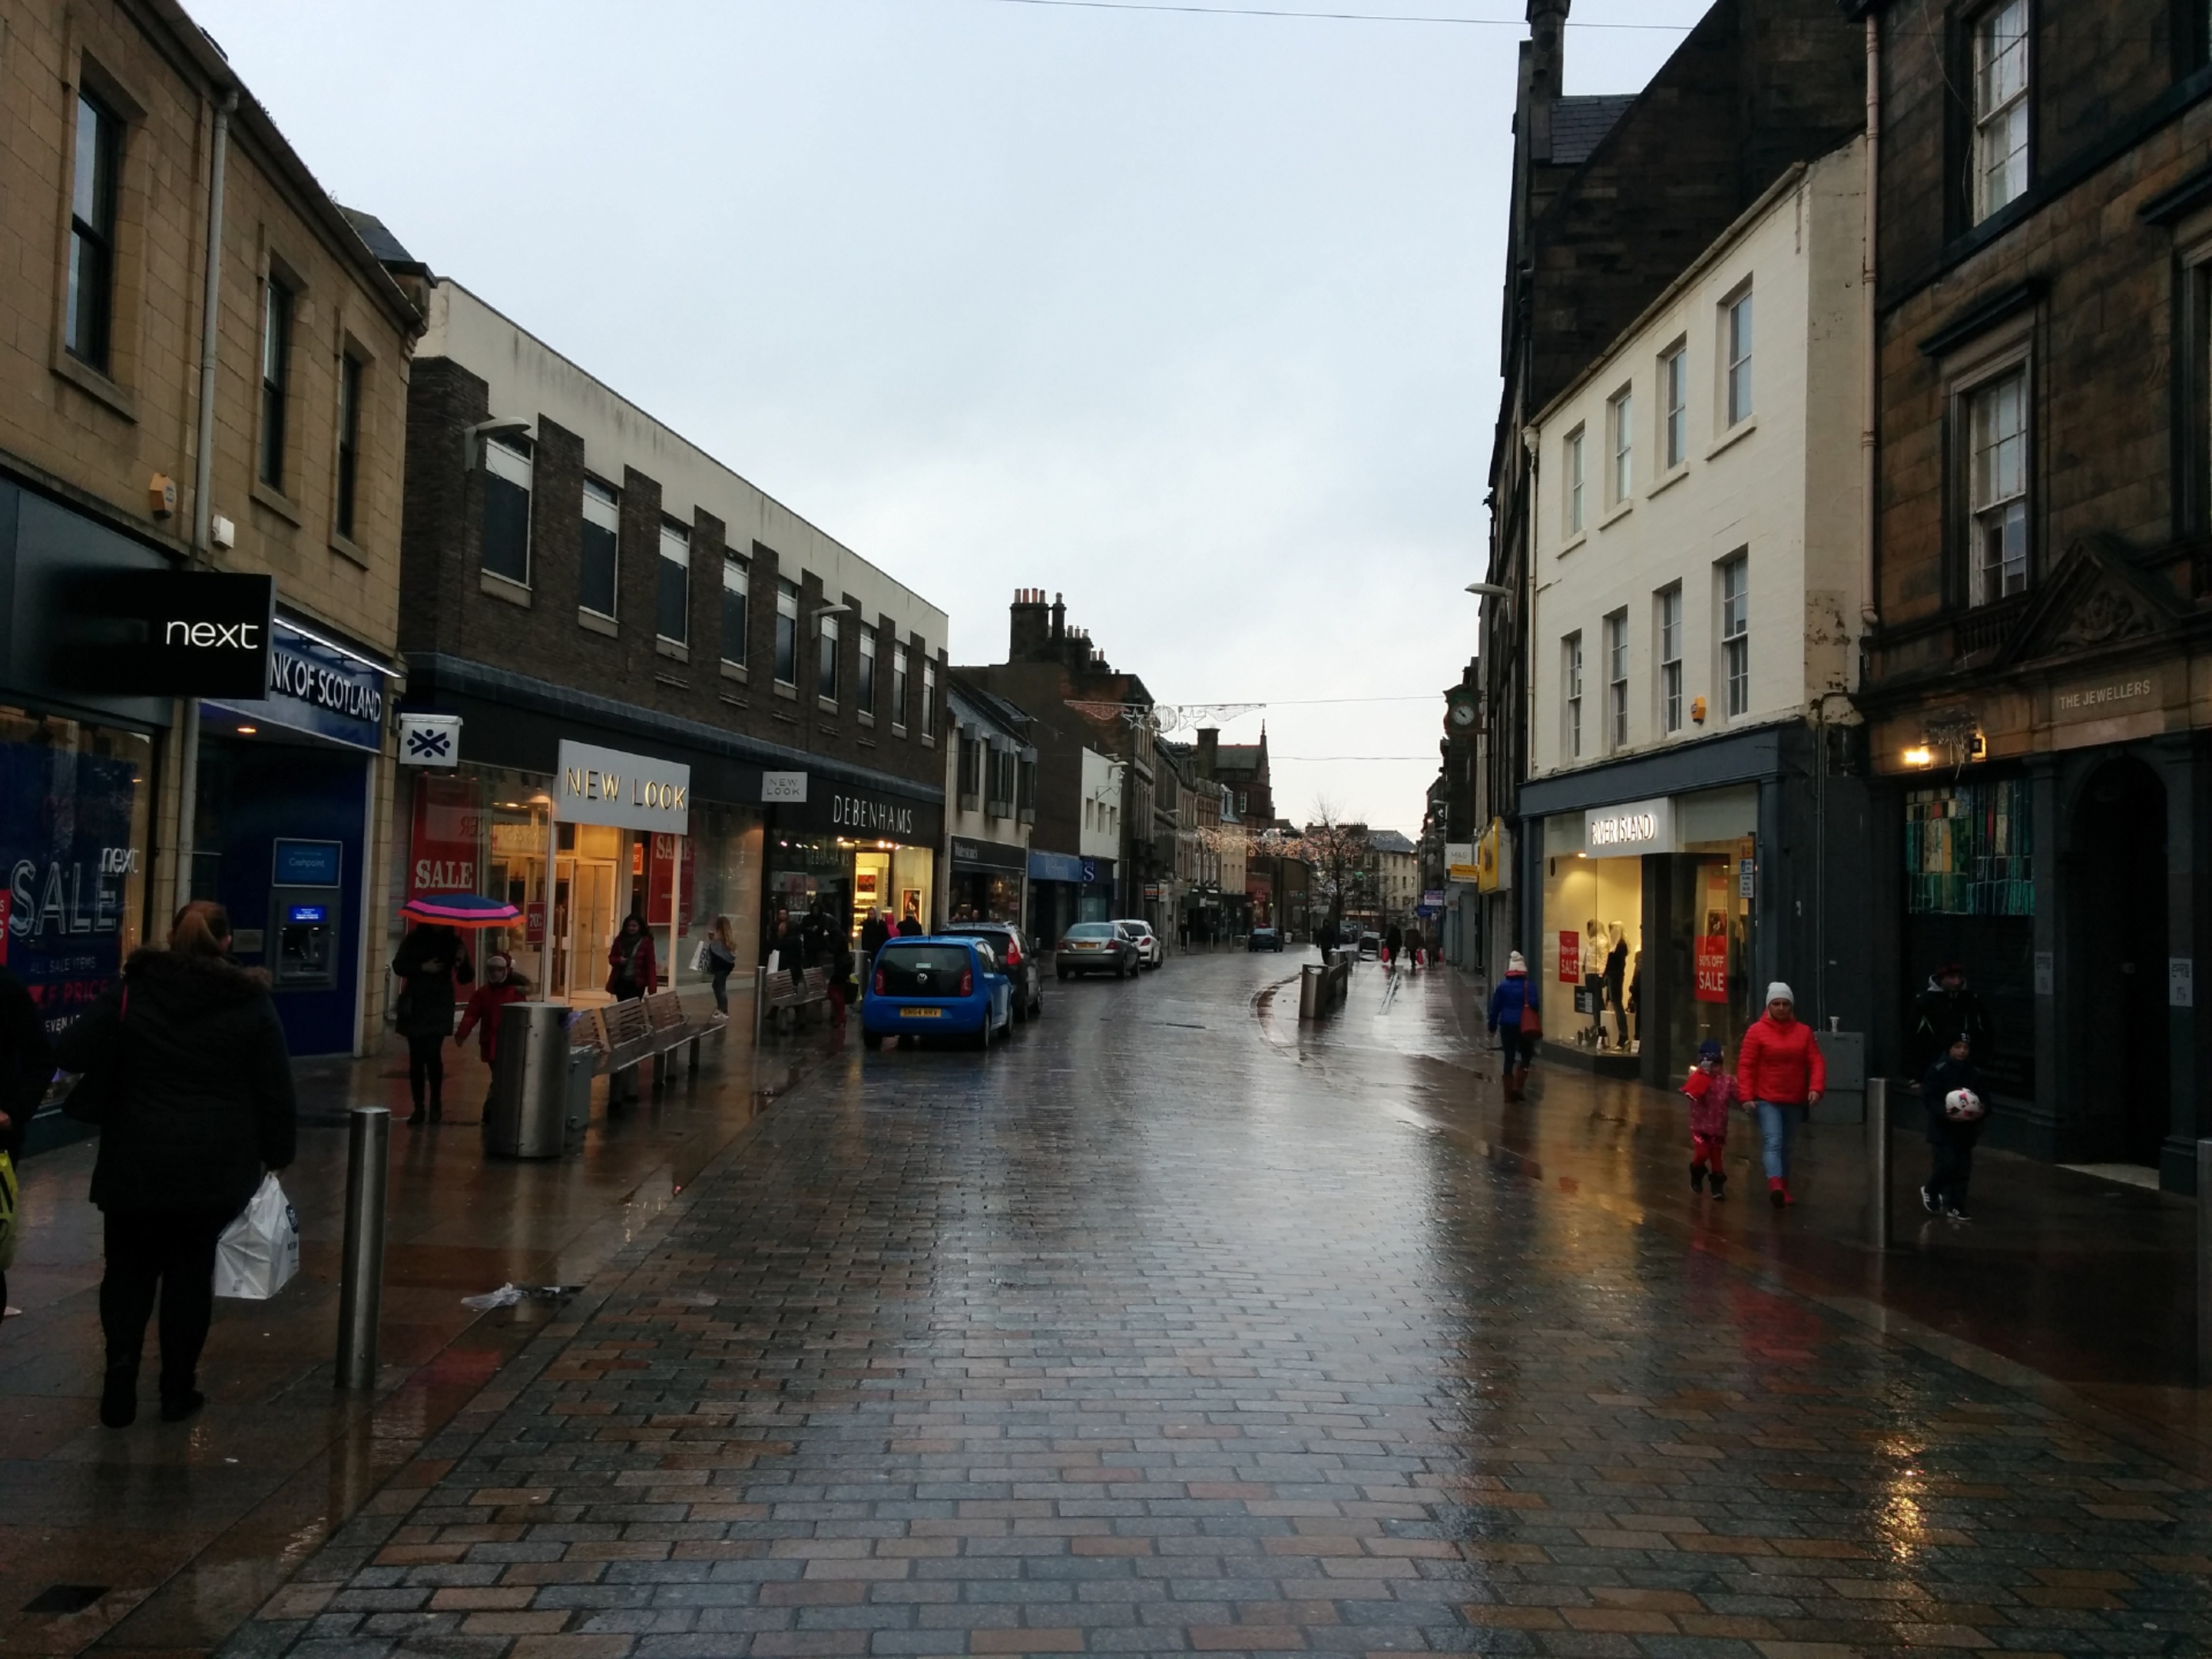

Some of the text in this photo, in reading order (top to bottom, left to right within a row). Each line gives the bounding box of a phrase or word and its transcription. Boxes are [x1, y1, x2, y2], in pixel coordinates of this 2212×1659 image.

[166, 621, 259, 649] next
[270, 651, 382, 723] NK OF SCOTLAND
[2060, 680, 2151, 710] THE JEWELLERS
[567, 767, 687, 811] NEW LOOK
[767, 787, 800, 796] LOOK
[770, 778, 798, 786] NEW
[833, 795, 912, 834] DEBENHAMS
[1591, 814, 1654, 845] RIVER ISLAND
[102, 846, 139, 873] next
[656, 834, 691, 861] SAE
[288, 857, 326, 869] Cashpoint
[415, 859, 473, 889] SALE
[9, 859, 118, 936] SALE
[49, 957, 71, 973] SALE
[72, 956, 97, 970] ITEMS
[1561, 959, 1578, 975] SALE
[1711, 955, 1724, 968] OFF
[1698, 971, 1724, 992] SALE
